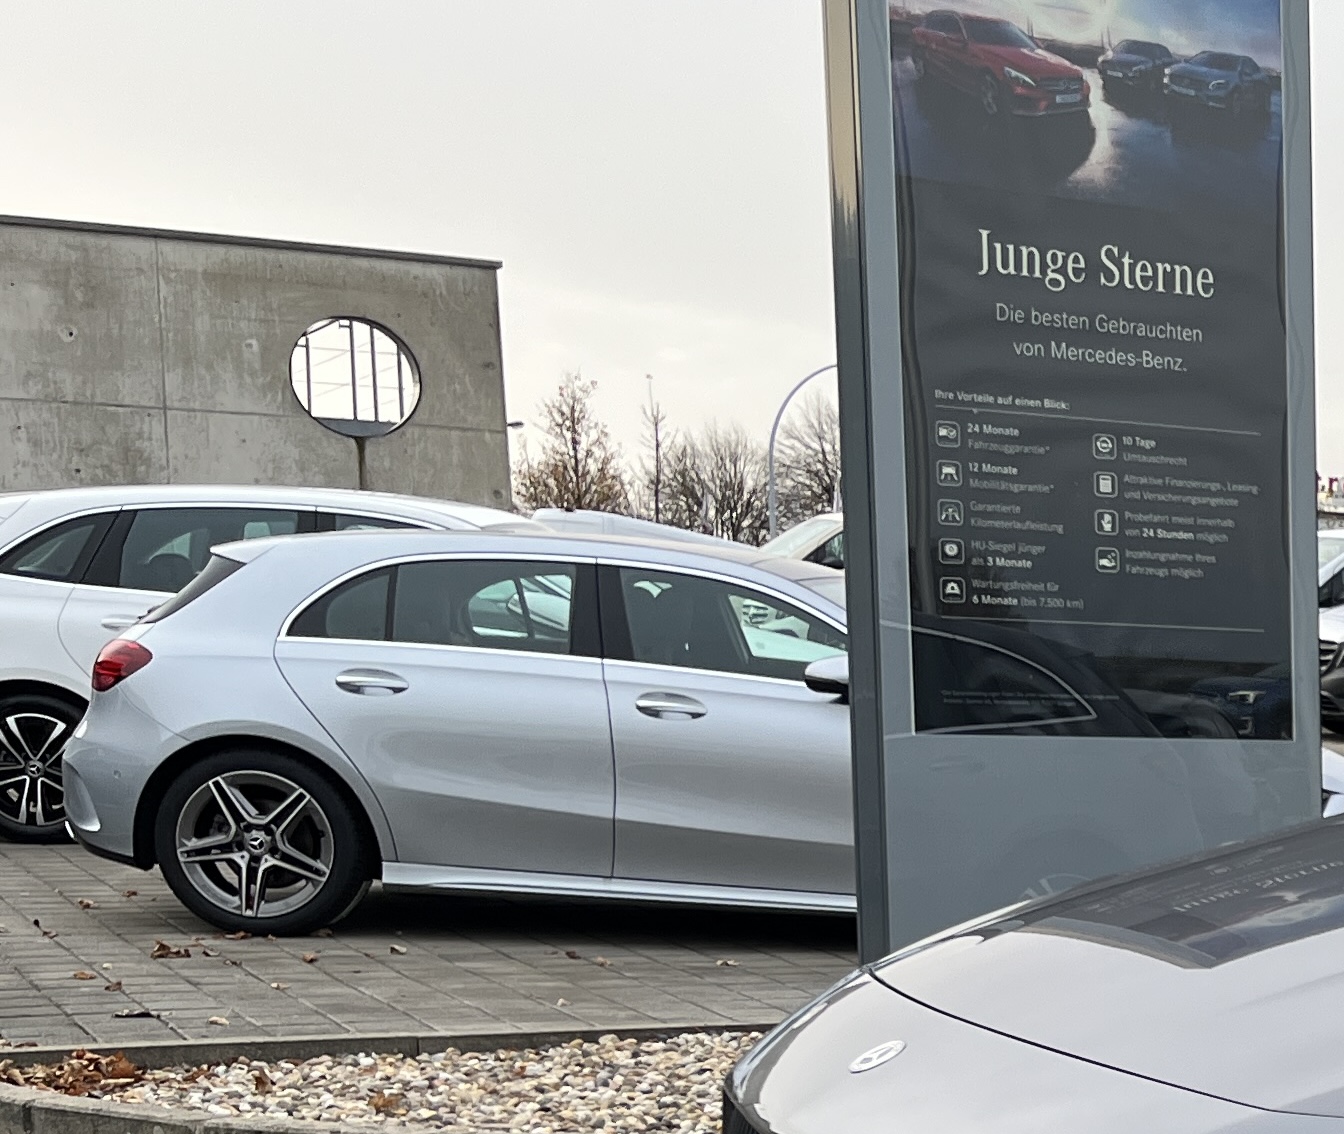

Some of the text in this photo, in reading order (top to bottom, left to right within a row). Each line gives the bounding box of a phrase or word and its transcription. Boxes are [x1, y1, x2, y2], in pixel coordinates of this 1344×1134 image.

[978, 228, 1214, 298] Junge Sterne
[996, 303, 1202, 342] Die besten Gebrauchten
[1013, 340, 1188, 372] von Mercedes-Benz.
[935, 389, 954, 400] Ihre
[956, 391, 994, 404] Vorteile
[997, 395, 1013, 405] auf
[1015, 397, 1042, 407] einen
[967, 423, 1020, 436] 24 Monate
[1123, 436, 1156, 450] 10 Tage
[968, 462, 1018, 475] 12 Monate
[987, 557, 994, 566] 3
[996, 558, 1032, 569] Monate
[972, 595, 979, 604] 6
[982, 595, 1018, 606] Monate
